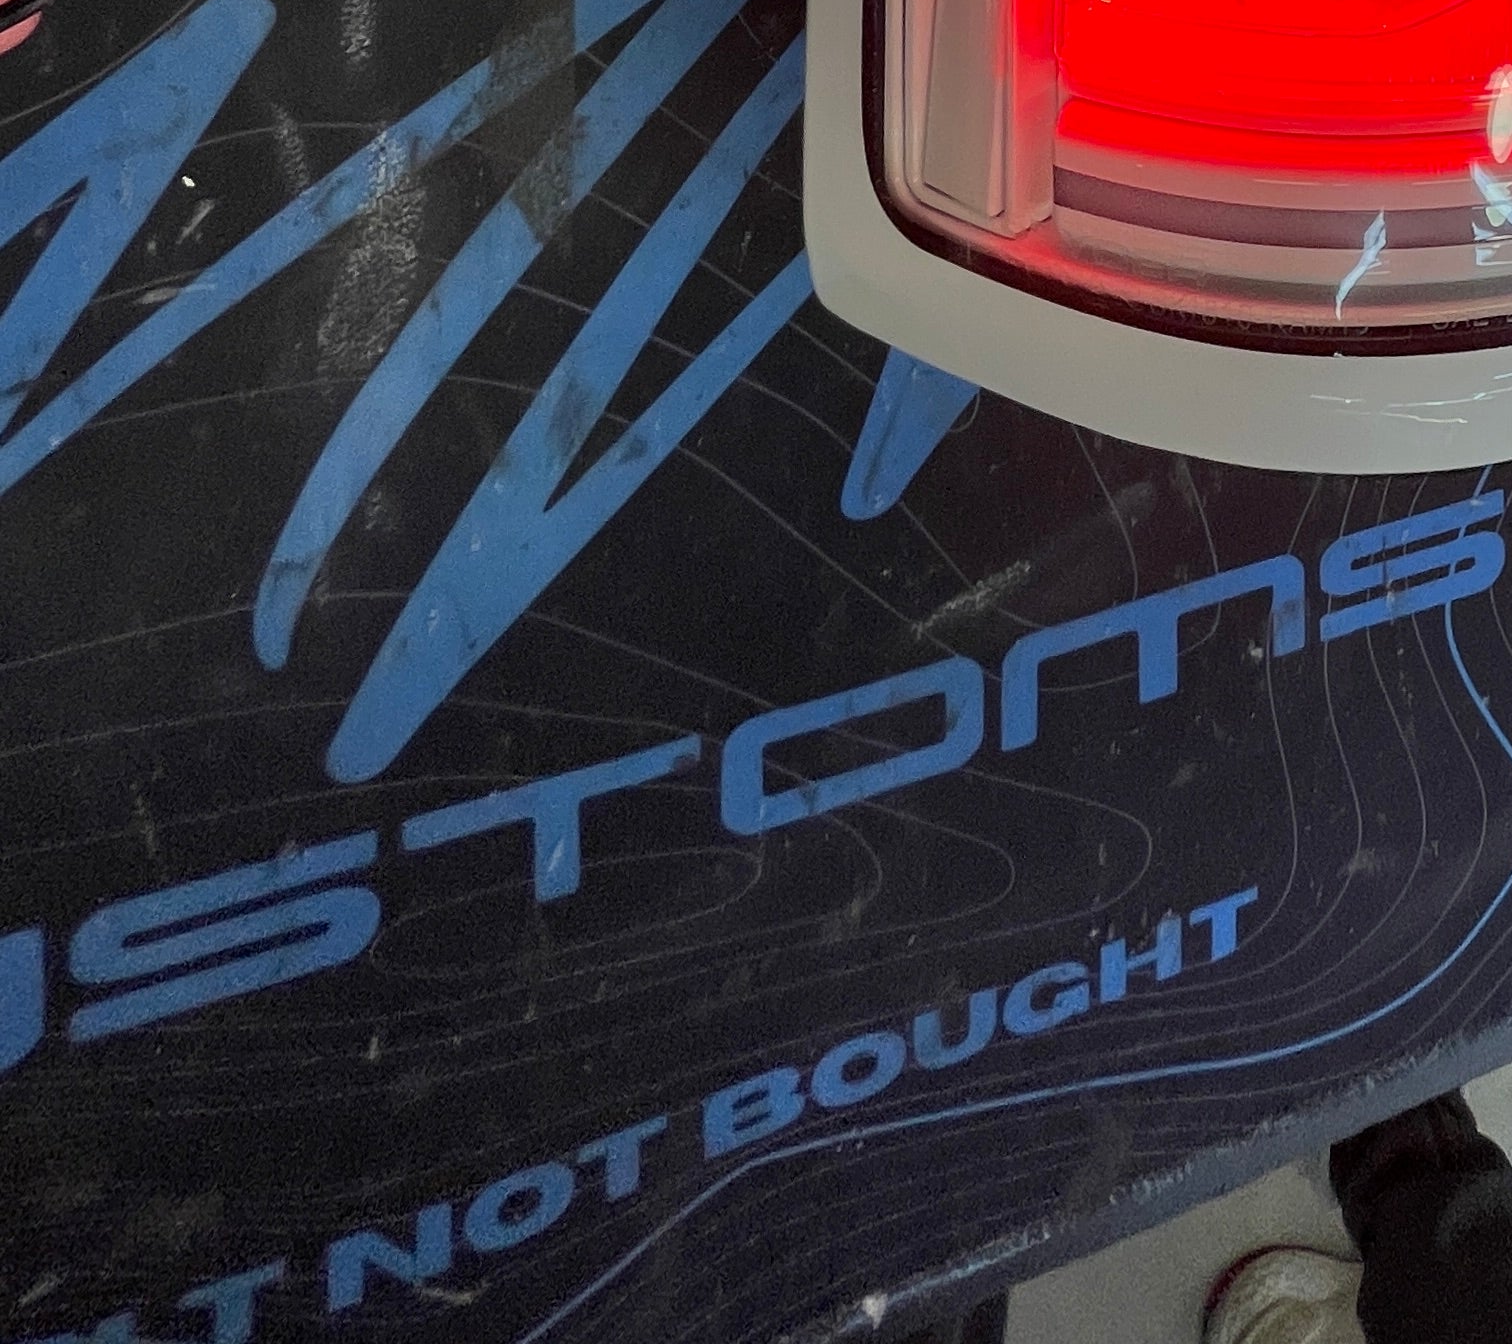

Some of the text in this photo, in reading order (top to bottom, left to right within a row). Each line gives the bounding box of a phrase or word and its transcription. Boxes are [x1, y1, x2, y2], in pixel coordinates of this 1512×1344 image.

[0, 488, 1506, 1070] STOMS
[326, 885, 1260, 1312] NOT BOUGHT
